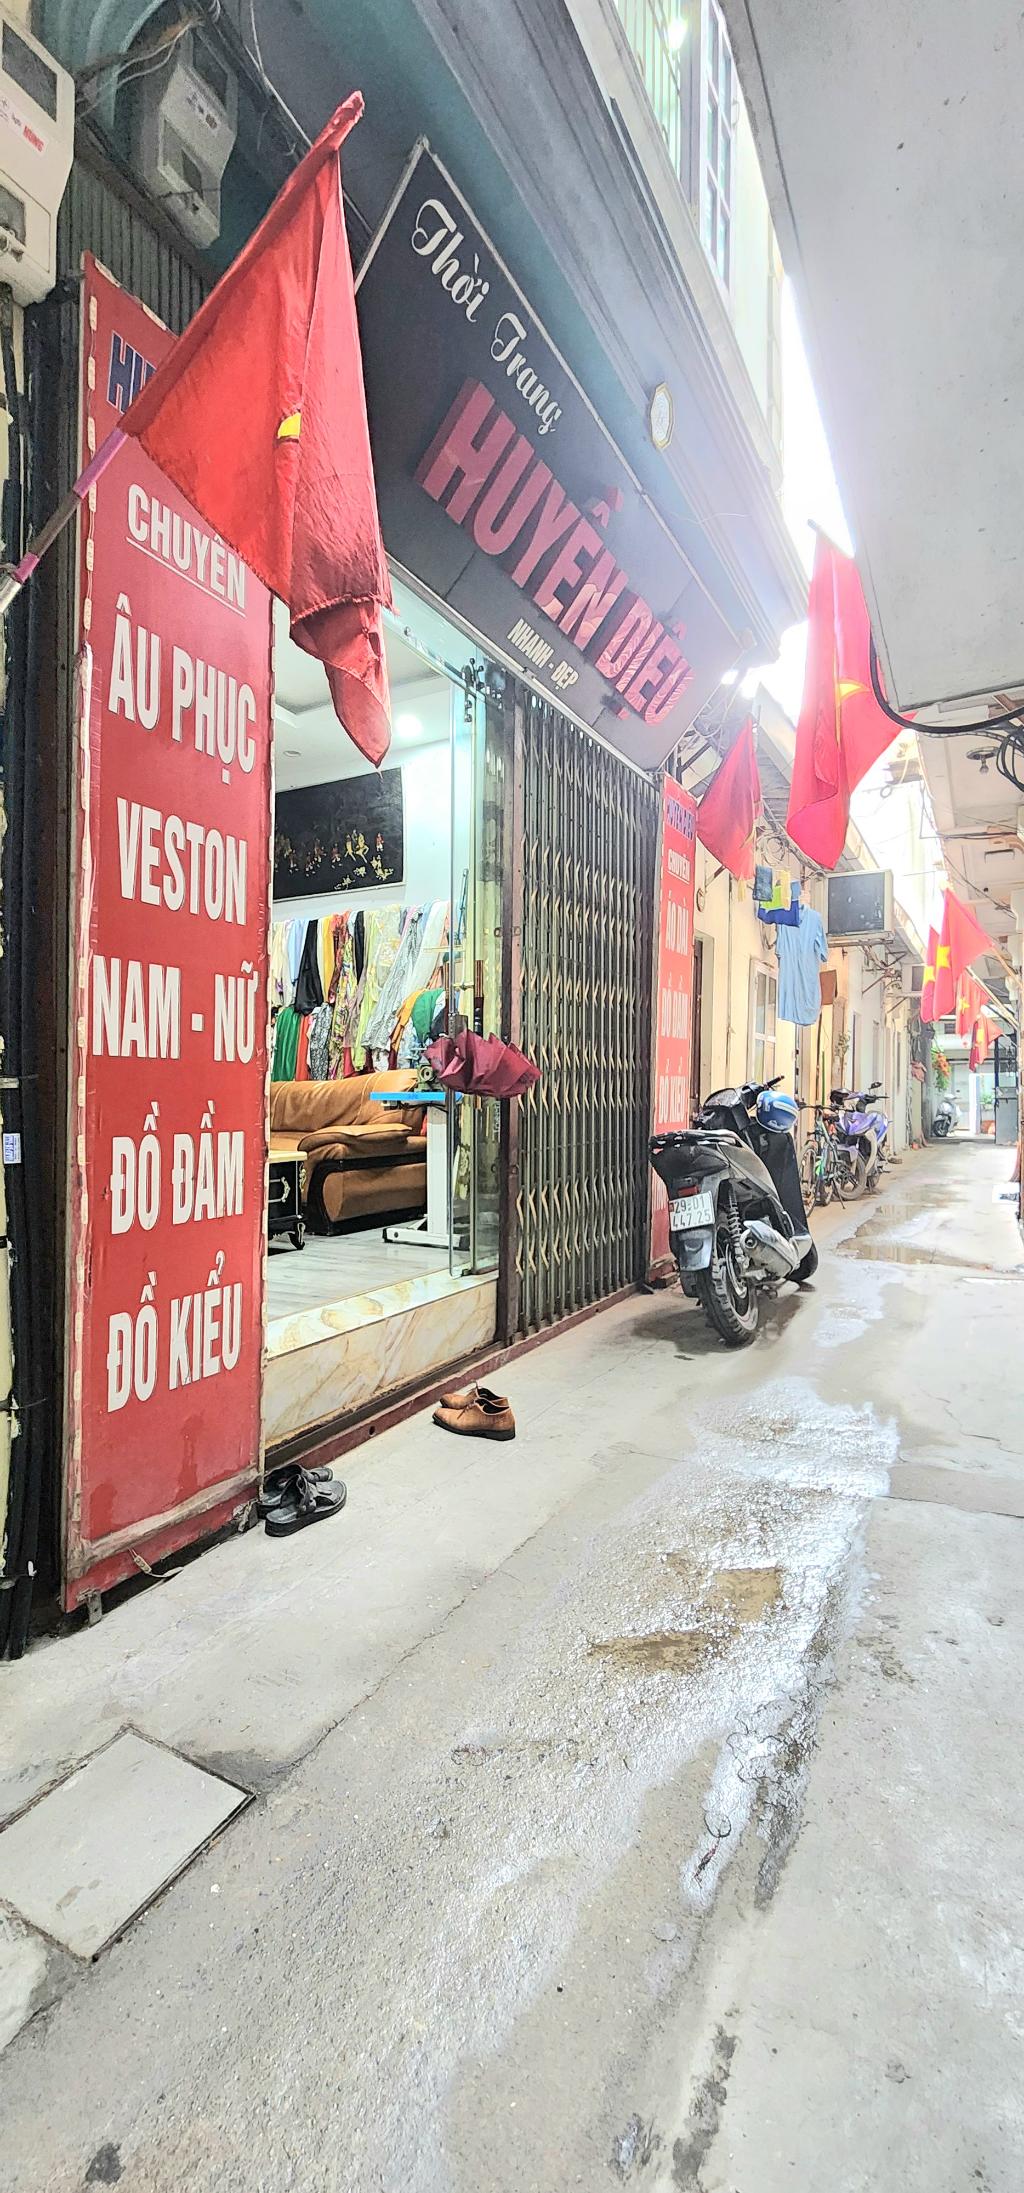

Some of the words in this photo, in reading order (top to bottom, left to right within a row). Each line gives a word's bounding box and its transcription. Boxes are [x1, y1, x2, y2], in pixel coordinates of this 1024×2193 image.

[411, 199, 489, 323] Thời
[490, 312, 562, 436] Trang
[128, 483, 246, 611] CHUYÊN
[416, 376, 628, 652] HUYỀN
[594, 591, 695, 726] DIỆU
[108, 592, 161, 731] ÂU
[171, 644, 257, 786] PHỤC
[507, 617, 555, 669] NHANH
[116, 797, 247, 927] VESTON
[92, 955, 181, 1059] NAM
[213, 960, 258, 1065] NỮ
[110, 1101, 161, 1235] ĐỒ
[171, 1100, 245, 1225] ĐẦM
[106, 1271, 158, 1413] ĐỒ
[169, 1250, 243, 1391] KIỂU
